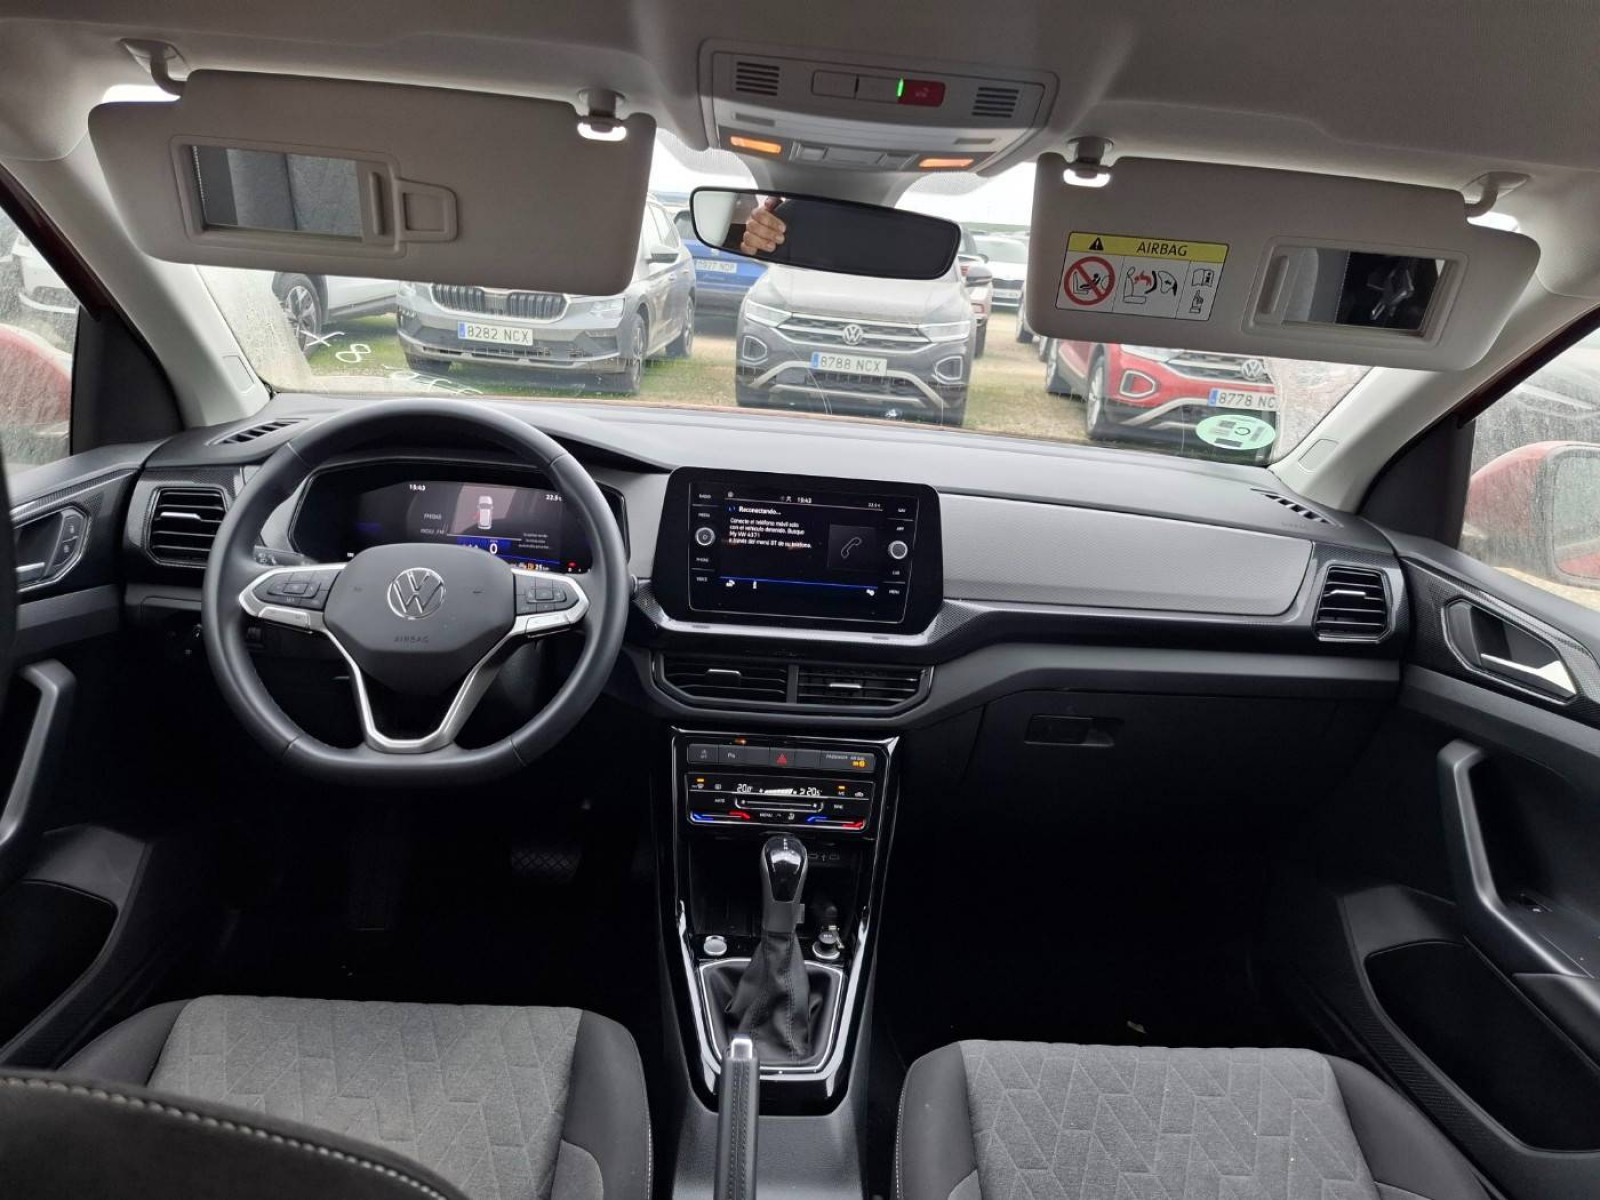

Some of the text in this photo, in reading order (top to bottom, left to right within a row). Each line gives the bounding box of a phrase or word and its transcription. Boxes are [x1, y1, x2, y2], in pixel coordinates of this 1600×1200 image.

[1136, 240, 1188, 256] AIRBAG
[467, 326, 529, 344] 8282 NCX
[821, 356, 882, 372] 8788 NCX
[1218, 392, 1252, 406] 8778
[738, 506, 781, 514] Reconectando...
[489, 543, 498, 554] 0
[394, 635, 429, 643] AIRBAG
